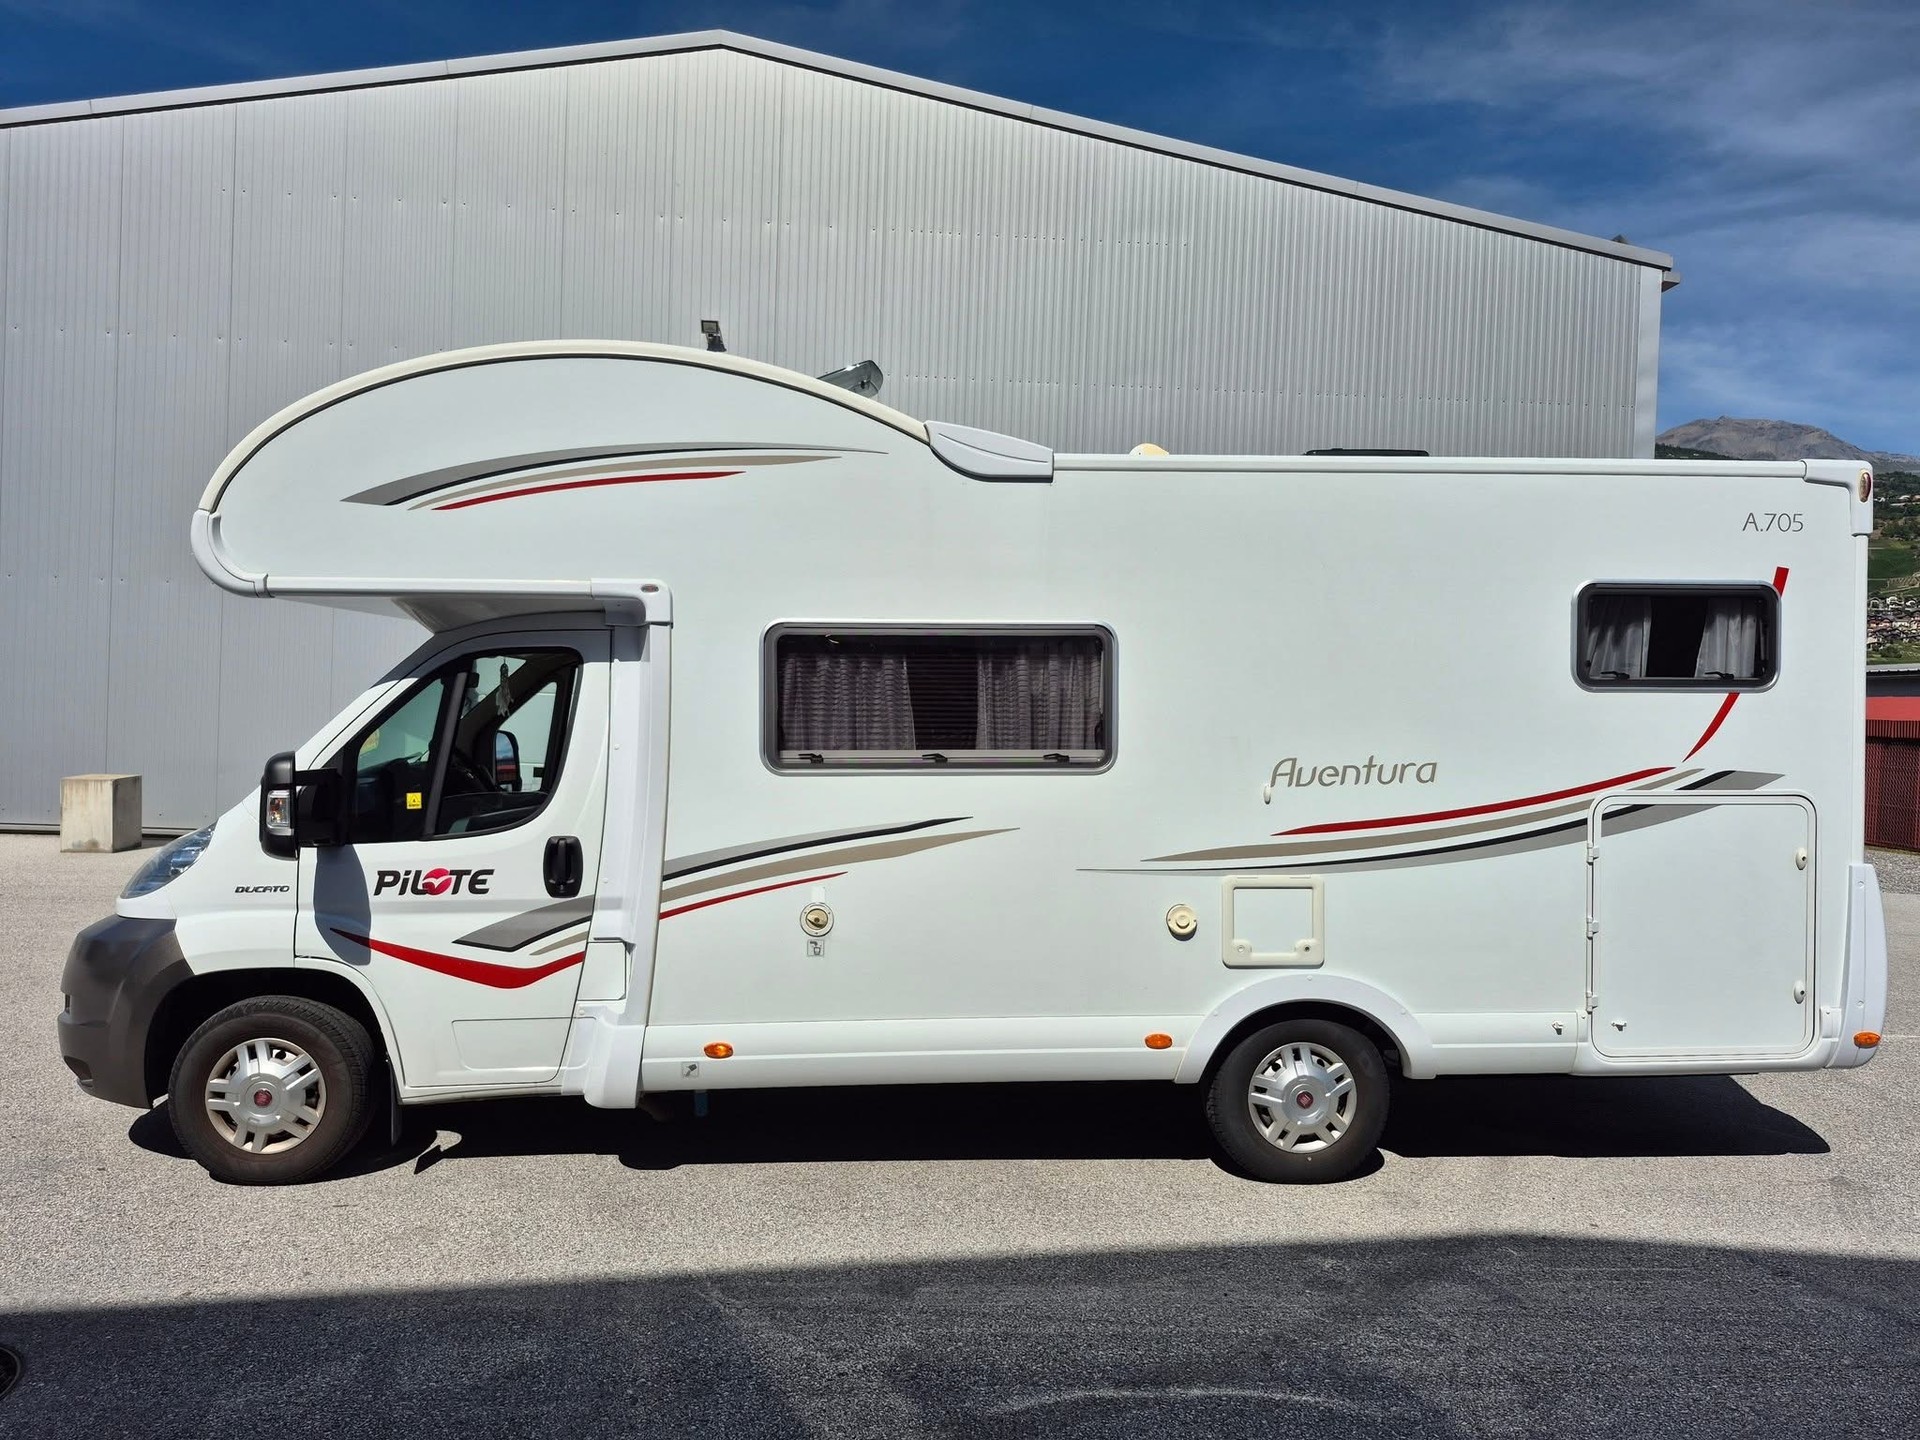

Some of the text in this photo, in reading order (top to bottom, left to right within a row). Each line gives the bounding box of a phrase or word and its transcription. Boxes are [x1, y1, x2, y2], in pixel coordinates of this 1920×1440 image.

[1742, 512, 1803, 533] A.705
[1270, 755, 1438, 788] Aventura
[234, 885, 290, 894] DUCATO
